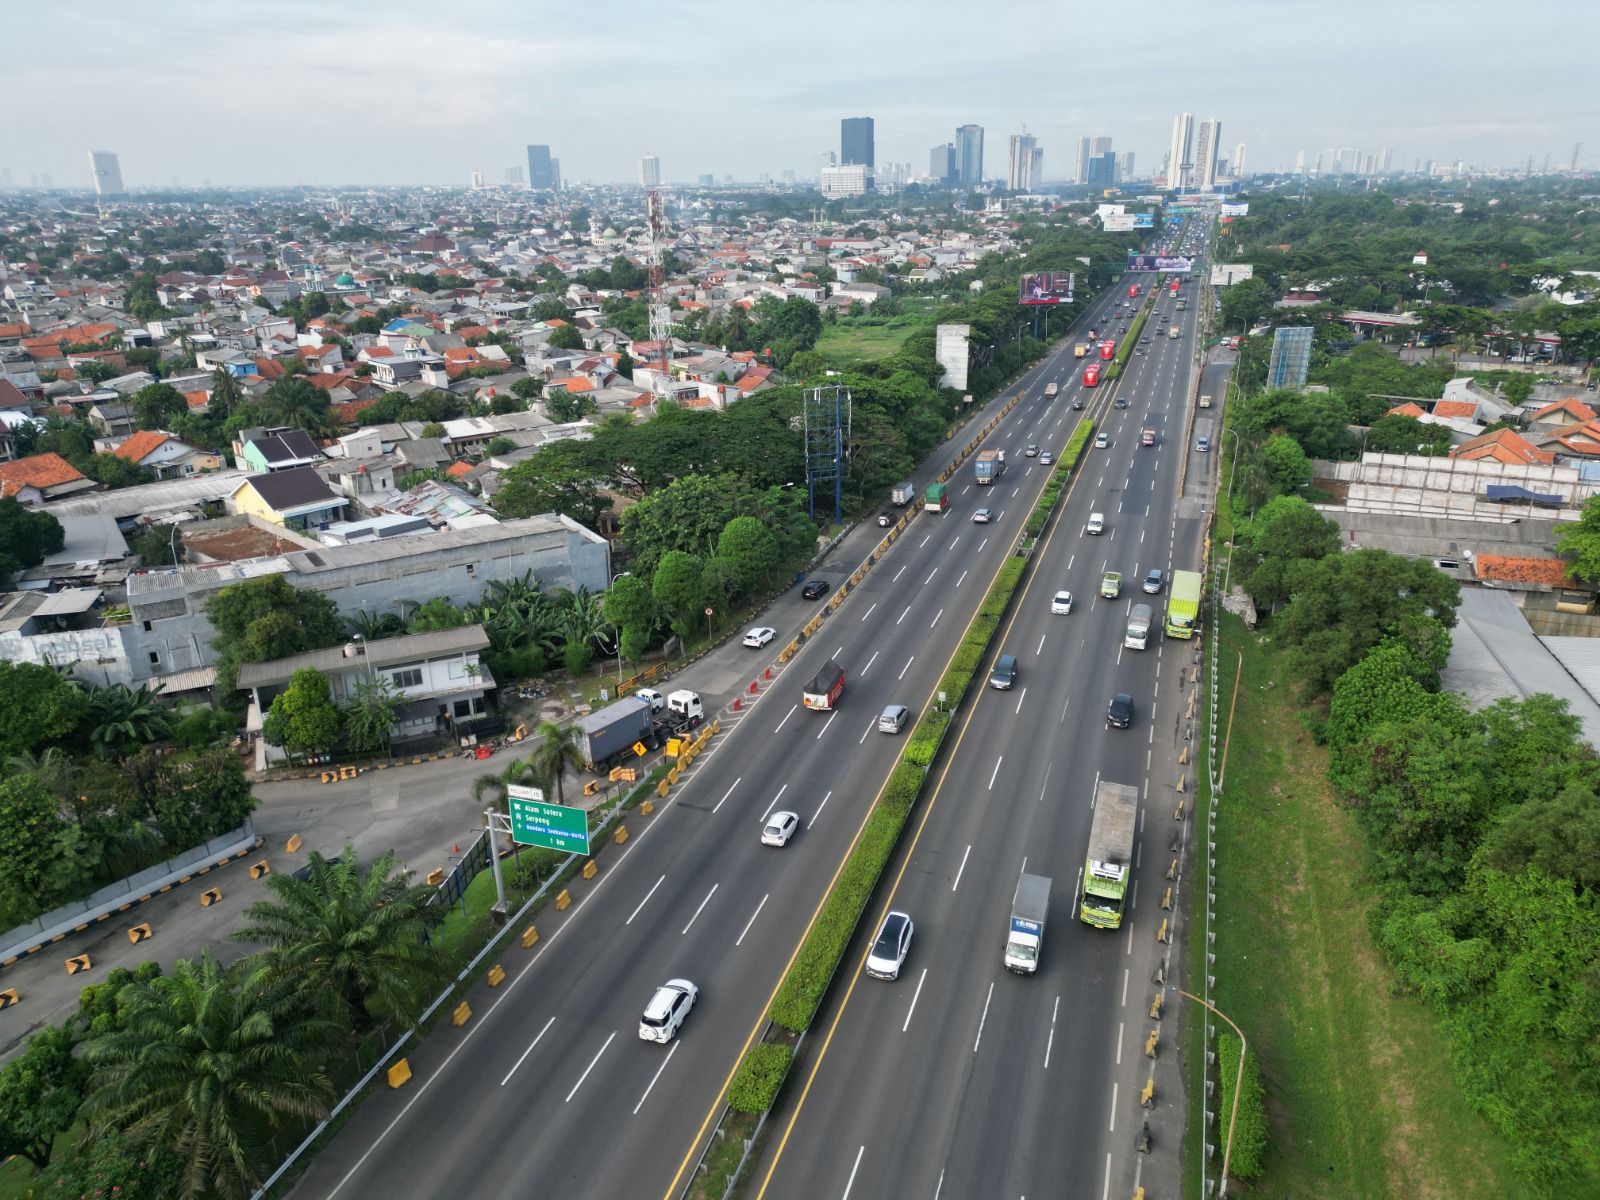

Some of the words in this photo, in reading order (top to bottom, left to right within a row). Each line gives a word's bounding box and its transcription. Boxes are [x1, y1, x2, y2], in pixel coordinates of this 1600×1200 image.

[524, 805, 540, 814] Alam
[525, 814, 550, 827] Serpong
[526, 824, 546, 833] Bandara
[556, 838, 565, 846] km
